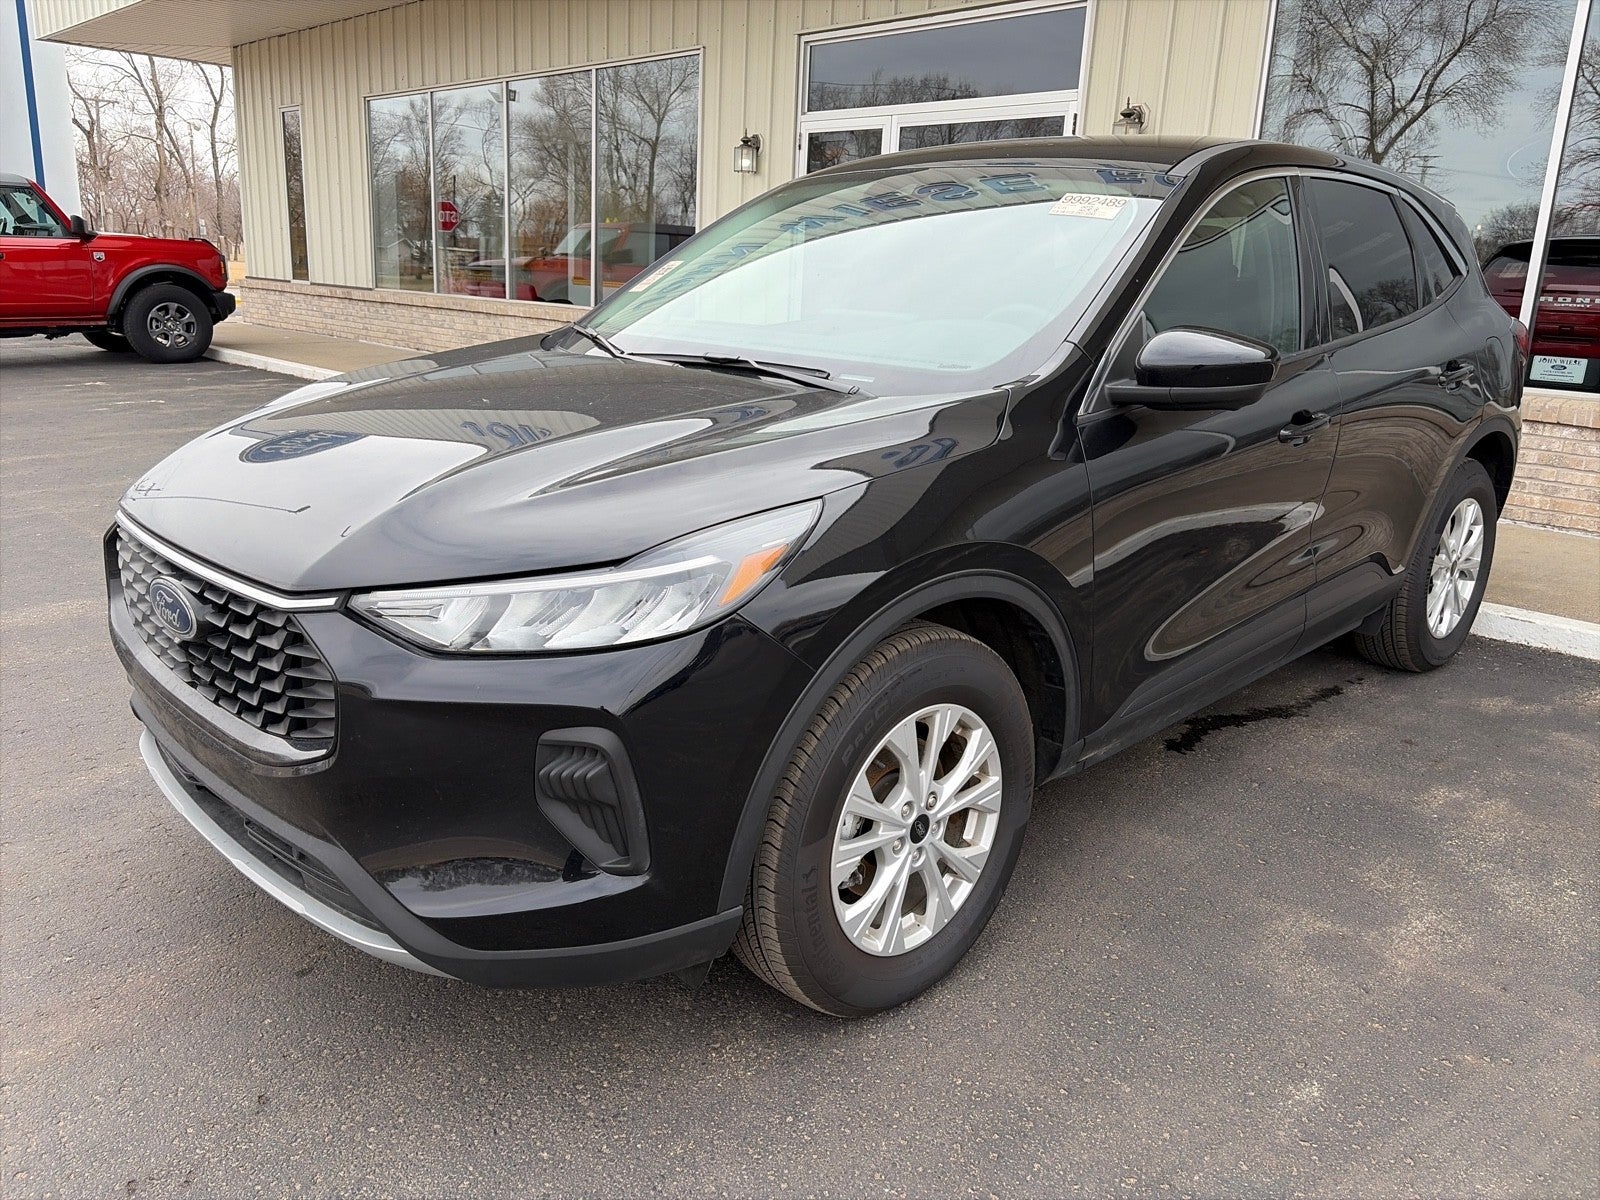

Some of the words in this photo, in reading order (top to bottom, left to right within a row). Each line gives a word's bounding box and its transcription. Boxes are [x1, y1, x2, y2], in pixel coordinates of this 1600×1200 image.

[1062, 195, 1127, 208] 9992489
[1540, 296, 1600, 304] RON
[154, 588, 181, 628] Ford
